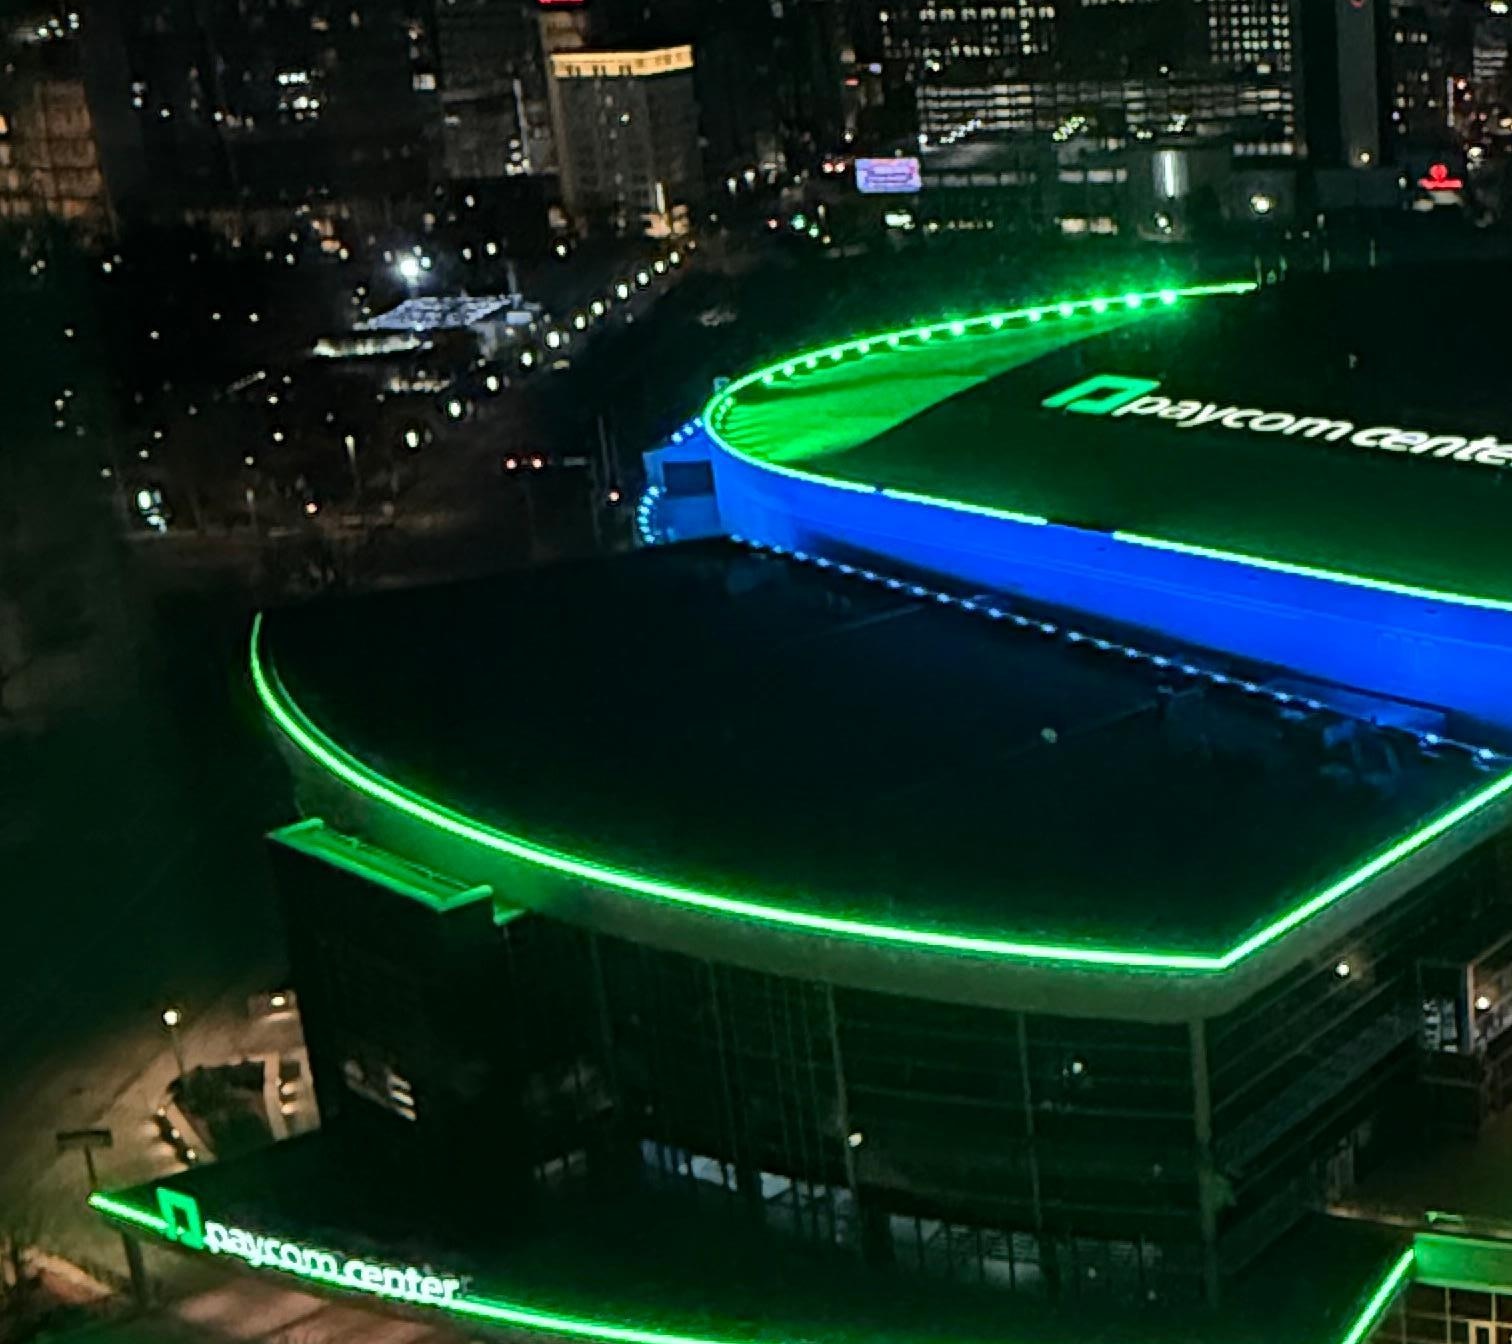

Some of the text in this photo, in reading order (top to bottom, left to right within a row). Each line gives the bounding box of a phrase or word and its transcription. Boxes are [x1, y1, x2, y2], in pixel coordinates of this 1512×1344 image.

[1113, 396, 1354, 441] paycom
[203, 1220, 460, 1305] paycom center
